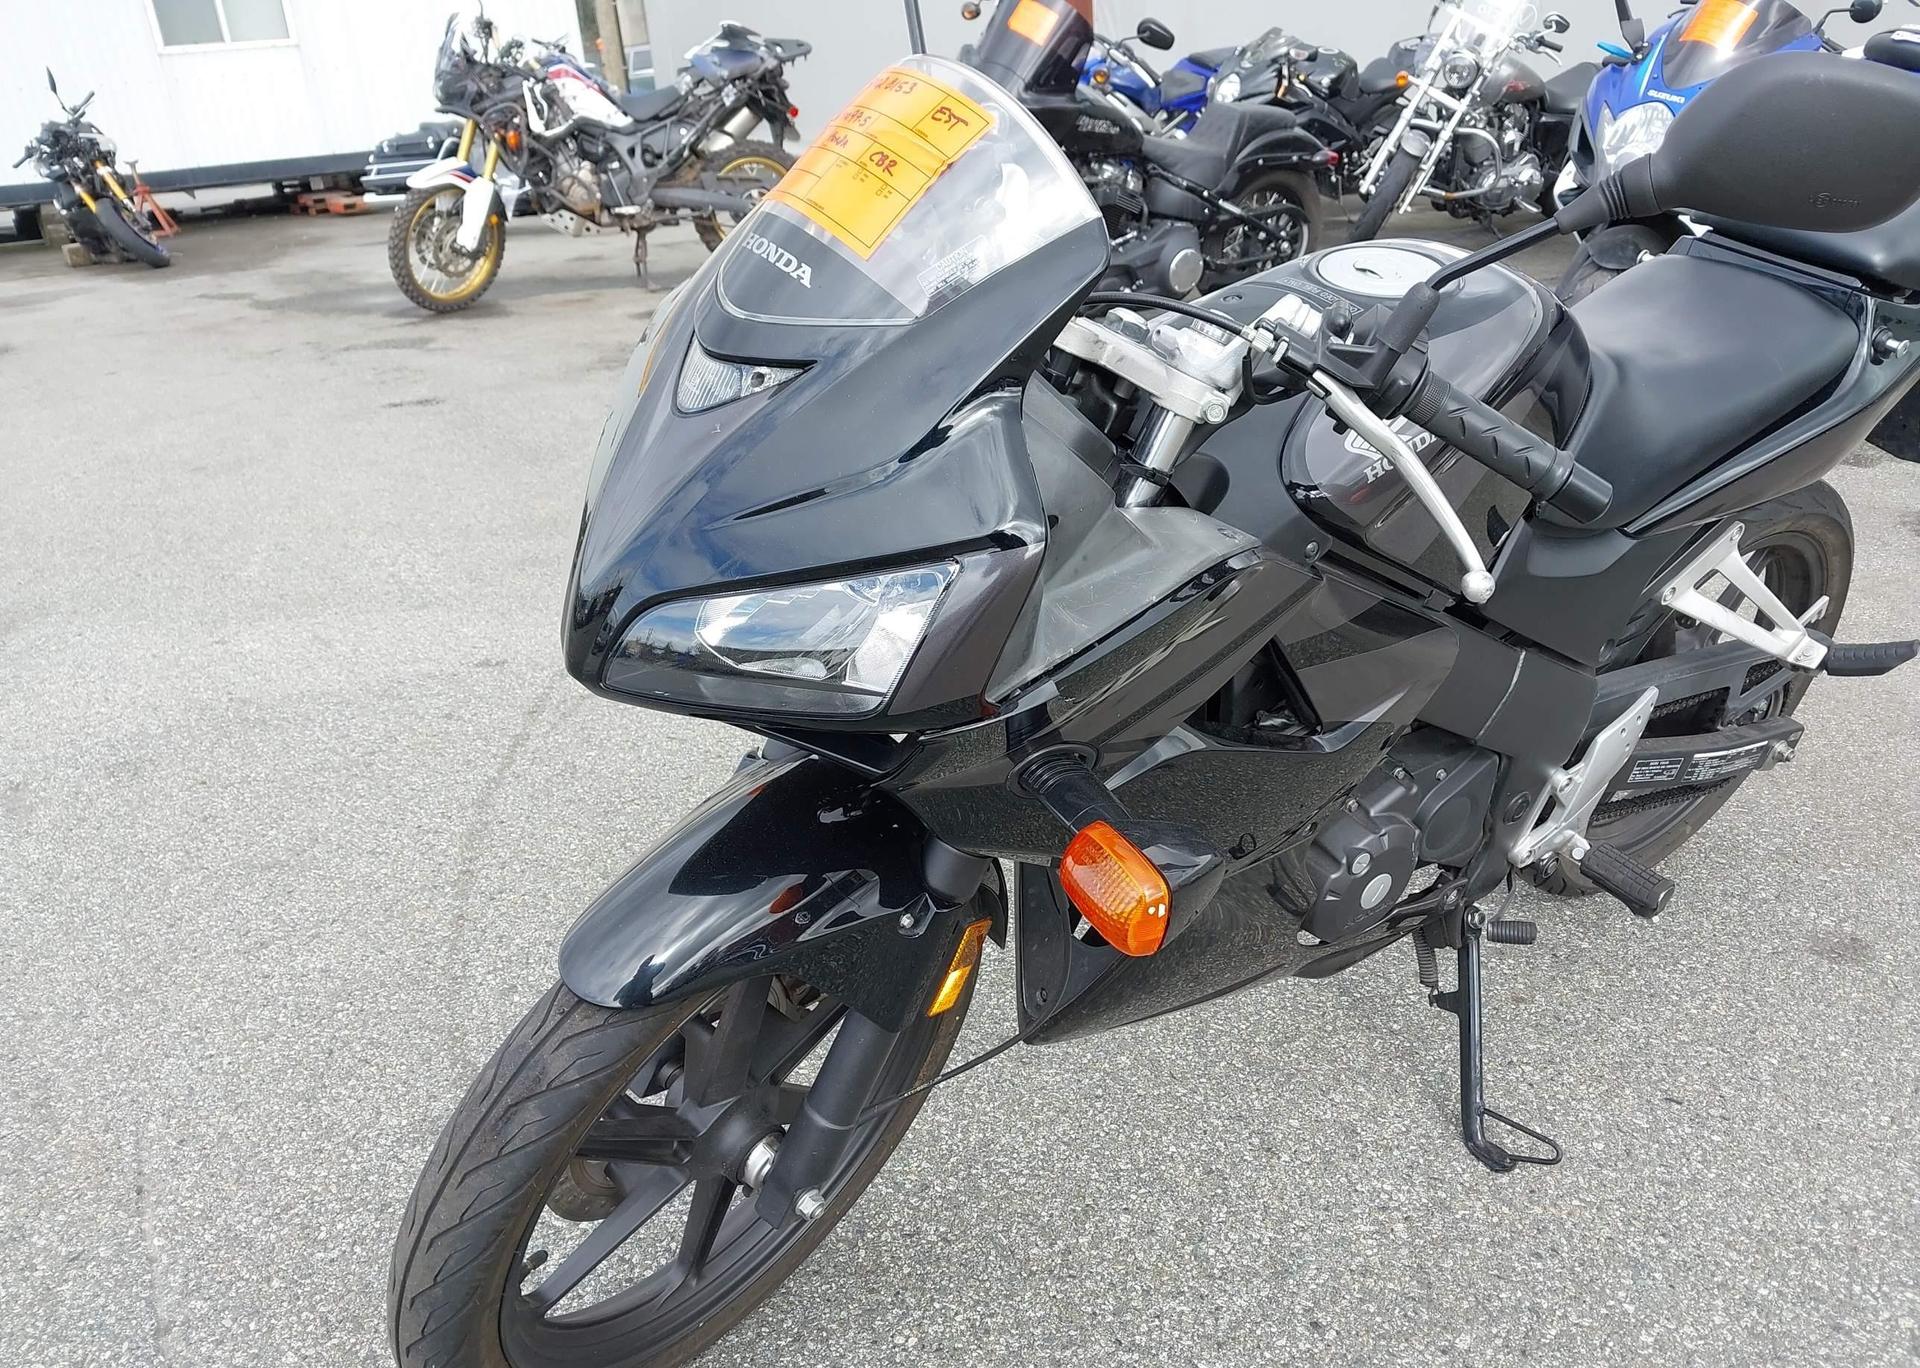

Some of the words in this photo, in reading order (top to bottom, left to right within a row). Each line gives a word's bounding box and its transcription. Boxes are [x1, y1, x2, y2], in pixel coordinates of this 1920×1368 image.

[1646, 89, 1686, 104] SUZUKI
[931, 105, 969, 131] EST
[868, 151, 898, 177] CBR
[742, 232, 812, 289] HONDA
